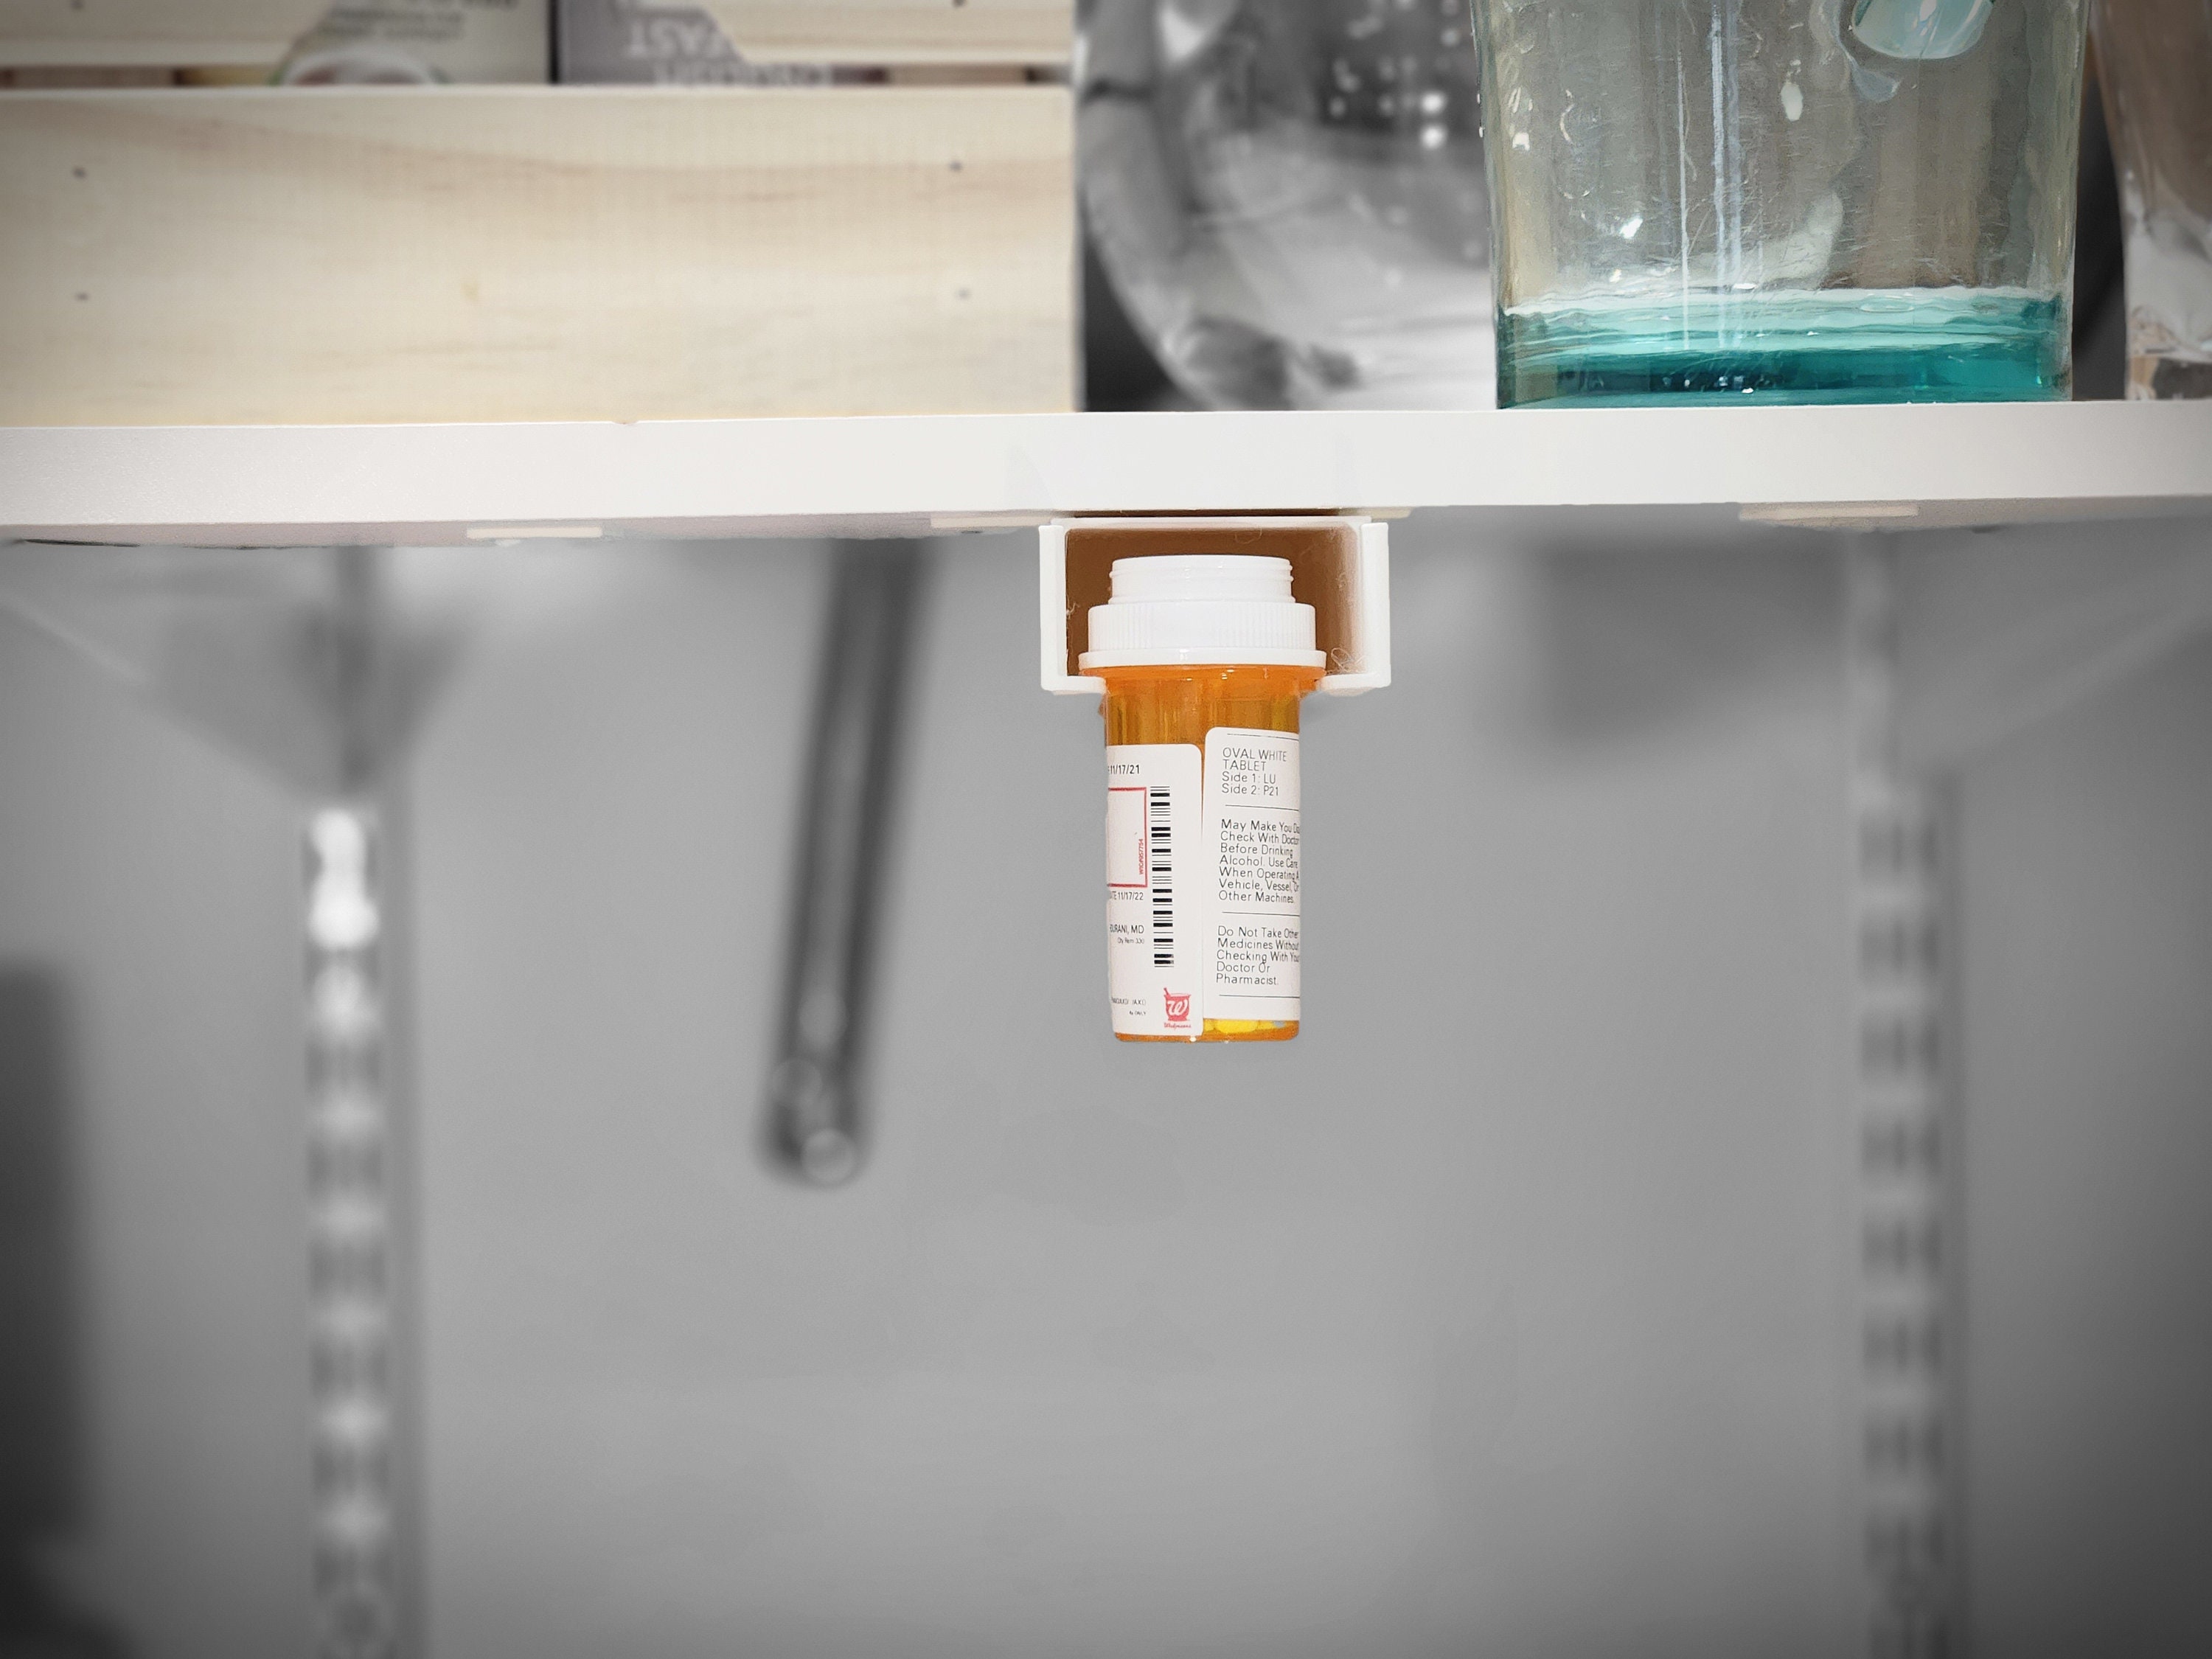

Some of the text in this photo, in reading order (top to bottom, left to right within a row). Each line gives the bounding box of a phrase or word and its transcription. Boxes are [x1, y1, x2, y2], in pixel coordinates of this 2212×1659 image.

[1222, 747, 1287, 762] OVAL WHITE
[1222, 759, 1267, 771] TABLET
[1222, 771, 1248, 782] Side
[1263, 773, 1276, 785] LU
[1222, 782, 1248, 794] Side
[1263, 785, 1279, 796] P21
[1221, 818, 1247, 832] May
[1251, 820, 1276, 831] Make
[1279, 821, 1292, 833] You
[1220, 830, 1255, 842] Check
[1258, 832, 1279, 844] With
[1220, 842, 1293, 858] Before Drinking
[1268, 856, 1284, 867] Use
[1219, 866, 1253, 877] When
[1219, 878, 1263, 891] Vehicle,
[1218, 889, 1252, 902] Other
[1130, 924, 1145, 934] MD
[1217, 925, 1234, 936] Do
[1238, 926, 1258, 937] Not
[1261, 927, 1282, 938] Take
[1217, 937, 1273, 950] Medicines
[1217, 949, 1267, 964] Checking
[1270, 950, 1289, 962] With
[1217, 961, 1270, 973] Doctor Or
